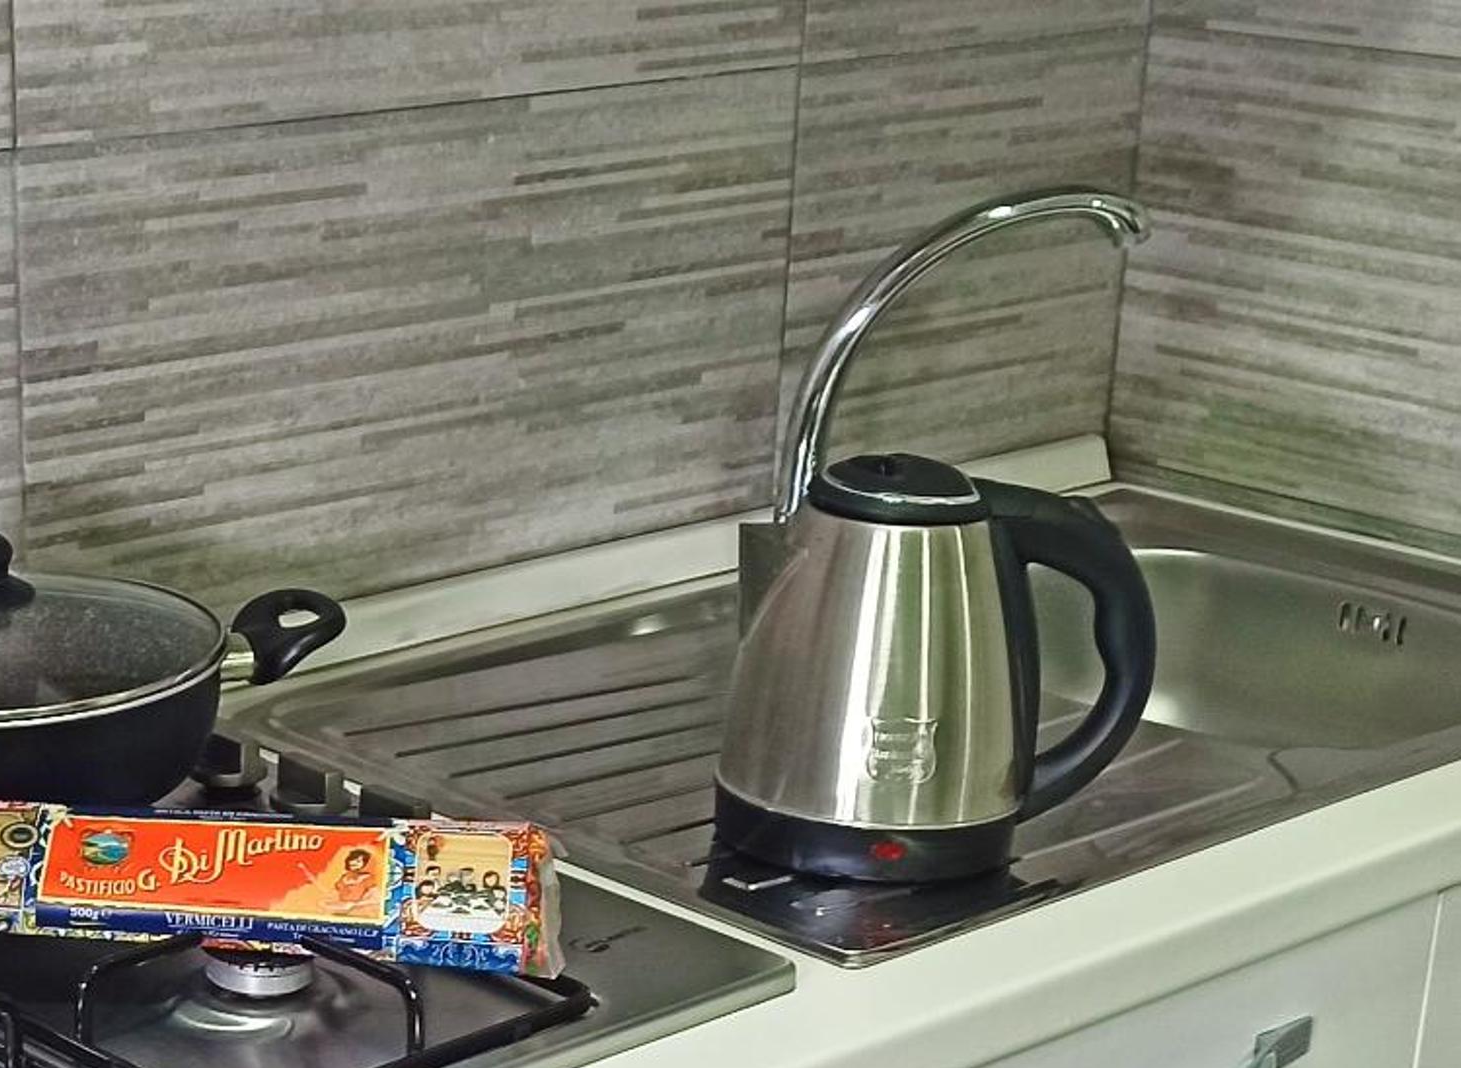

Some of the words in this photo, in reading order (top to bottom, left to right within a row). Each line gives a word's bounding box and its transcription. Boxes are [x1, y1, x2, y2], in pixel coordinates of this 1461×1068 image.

[60, 870, 136, 895] PASTIFICIO
[137, 868, 161, 891] G.
[159, 838, 211, 884] Di
[211, 828, 324, 881] Martino
[164, 911, 255, 930] VERMICELLI
